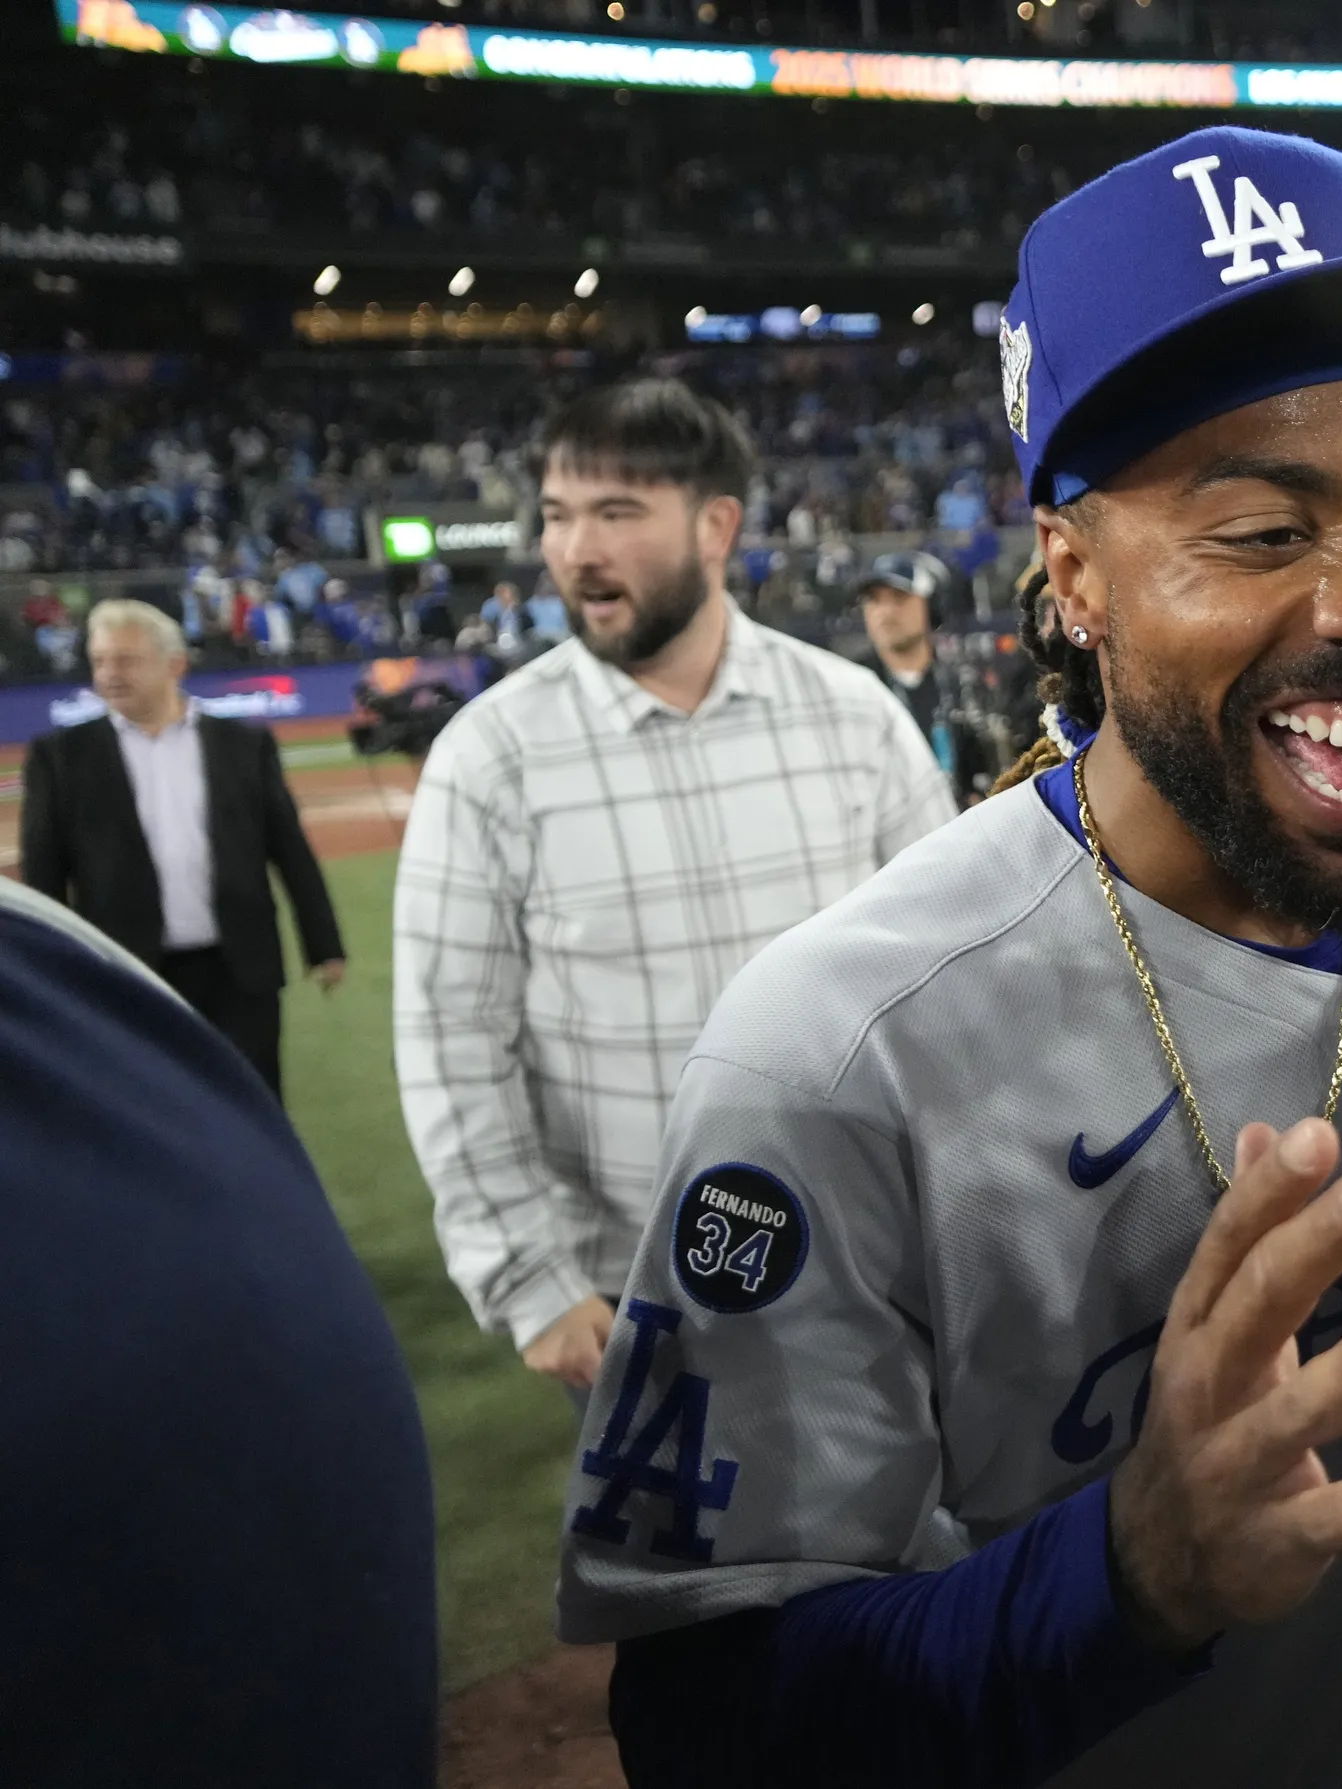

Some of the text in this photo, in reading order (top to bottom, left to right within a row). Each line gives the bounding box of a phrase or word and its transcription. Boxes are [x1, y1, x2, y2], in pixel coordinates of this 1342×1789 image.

[1172, 155, 1323, 285] LA
[687, 1212, 774, 1292] 34
[700, 1184, 787, 1228] FERNANDO
[571, 1298, 740, 1563] LA
